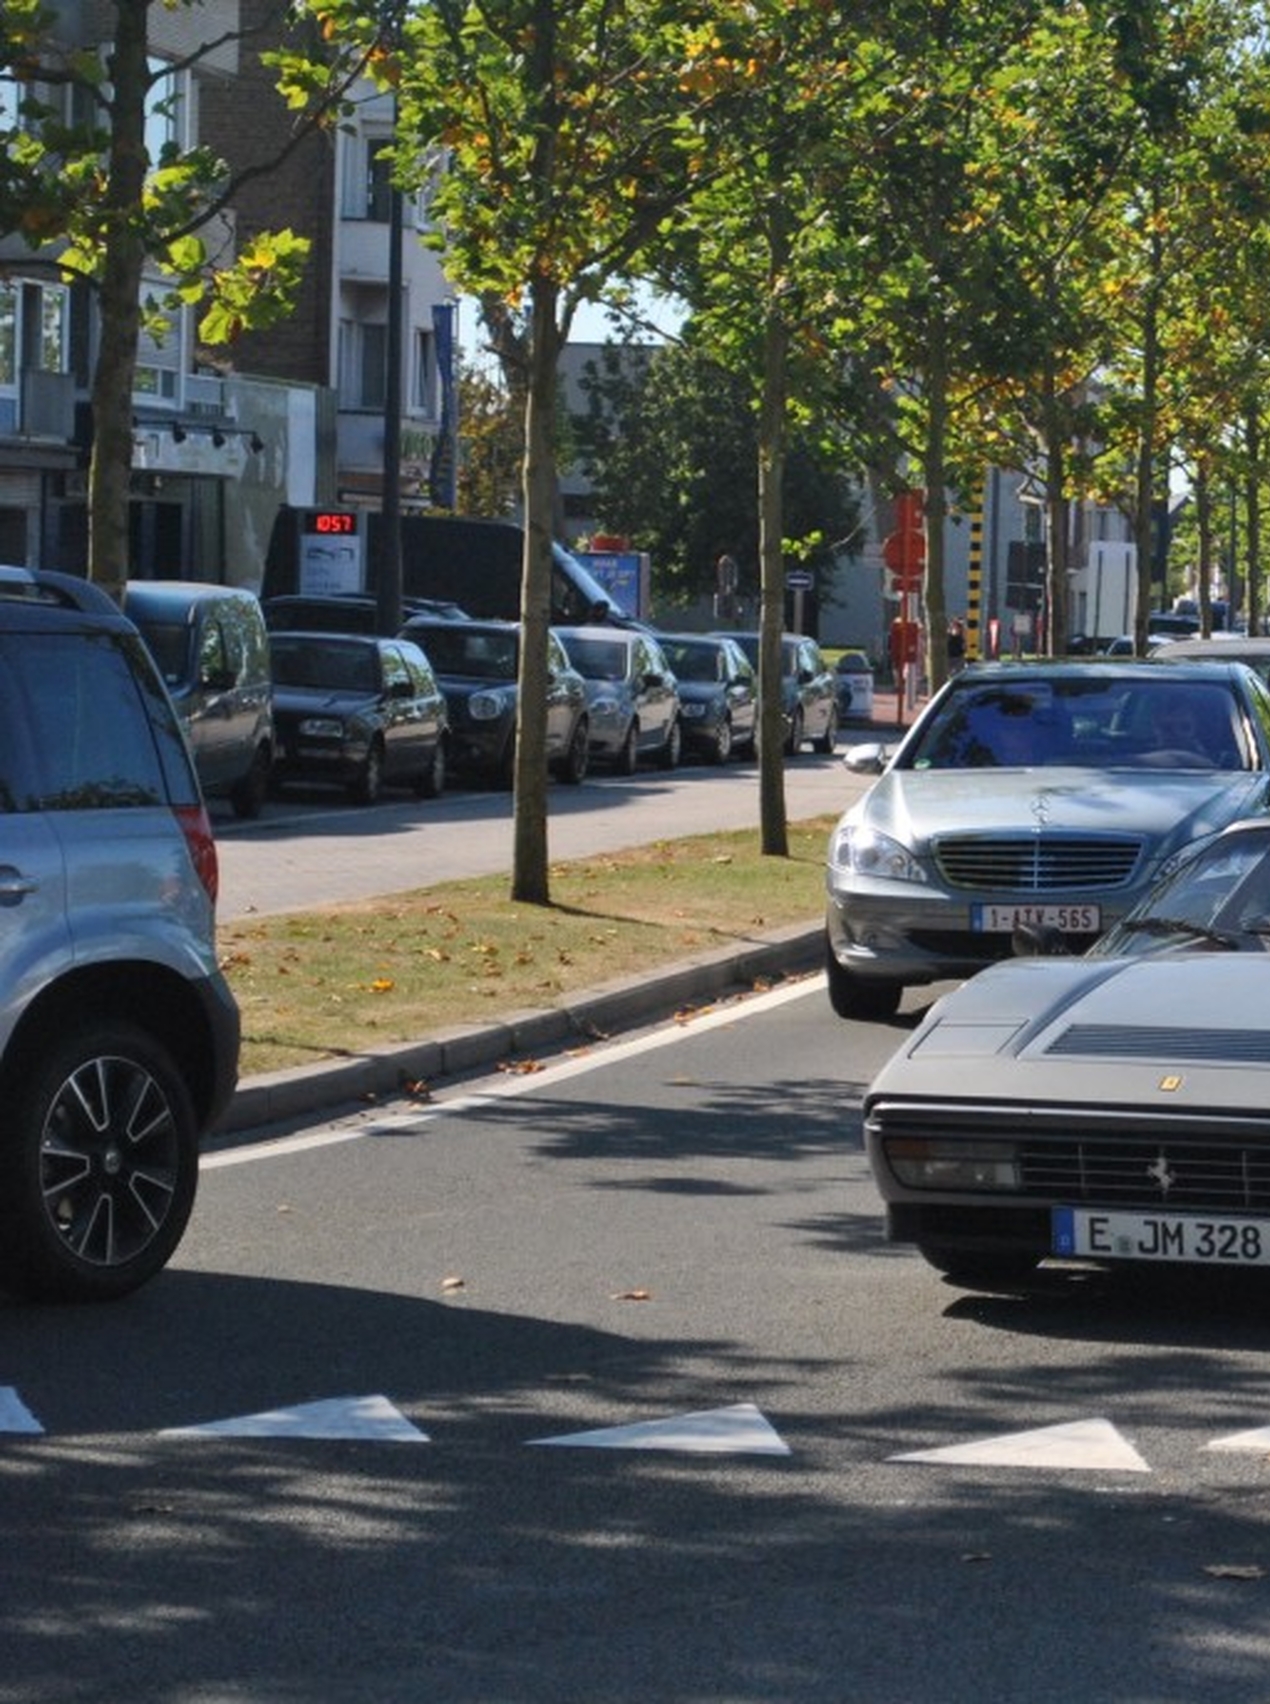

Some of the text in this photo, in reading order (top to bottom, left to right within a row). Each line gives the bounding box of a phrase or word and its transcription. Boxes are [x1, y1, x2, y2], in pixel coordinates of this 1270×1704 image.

[1088, 1217, 1262, 1260] E JM 328
